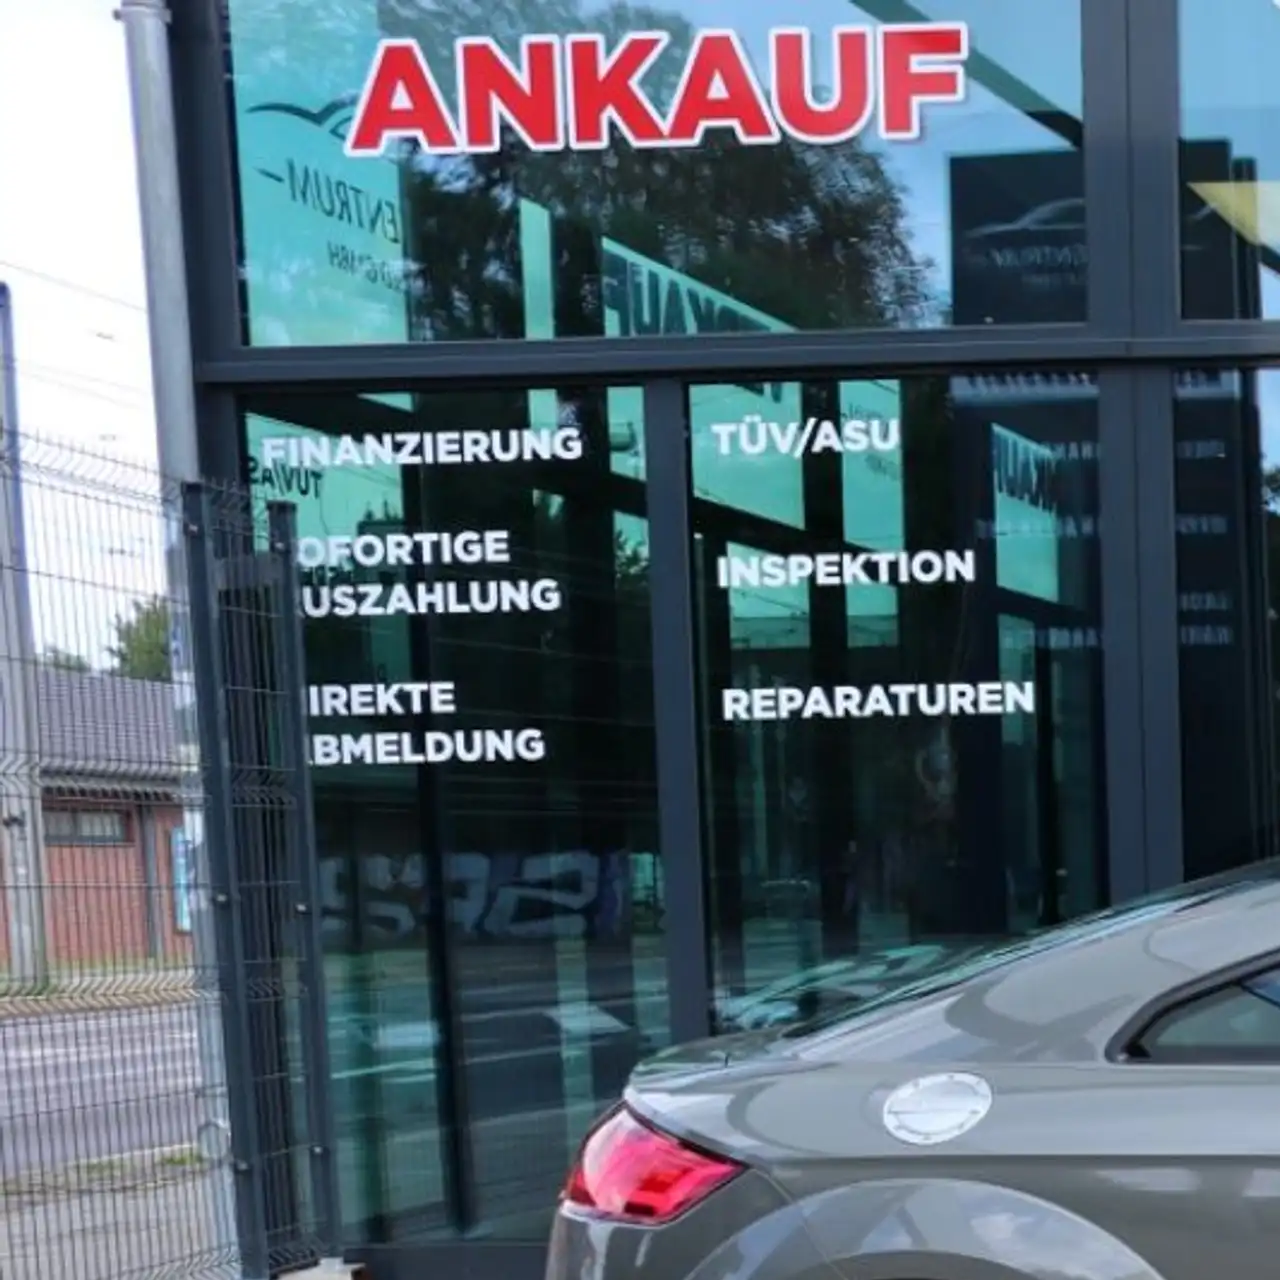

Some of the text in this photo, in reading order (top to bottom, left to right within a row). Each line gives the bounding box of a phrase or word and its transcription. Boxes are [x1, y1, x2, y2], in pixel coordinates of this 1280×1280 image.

[346, 21, 970, 157] ANKAUF
[261, 428, 583, 468] FINANZIERUNG
[710, 414, 900, 458] TÜV/ASU
[296, 530, 511, 568] OFORTIGE
[717, 550, 976, 588] INSPEKTION
[300, 579, 562, 619] USZAHLUNG
[308, 681, 457, 717] IREKTE
[722, 681, 1035, 721] REPARATUREN
[308, 728, 546, 766] BMELDUNG
